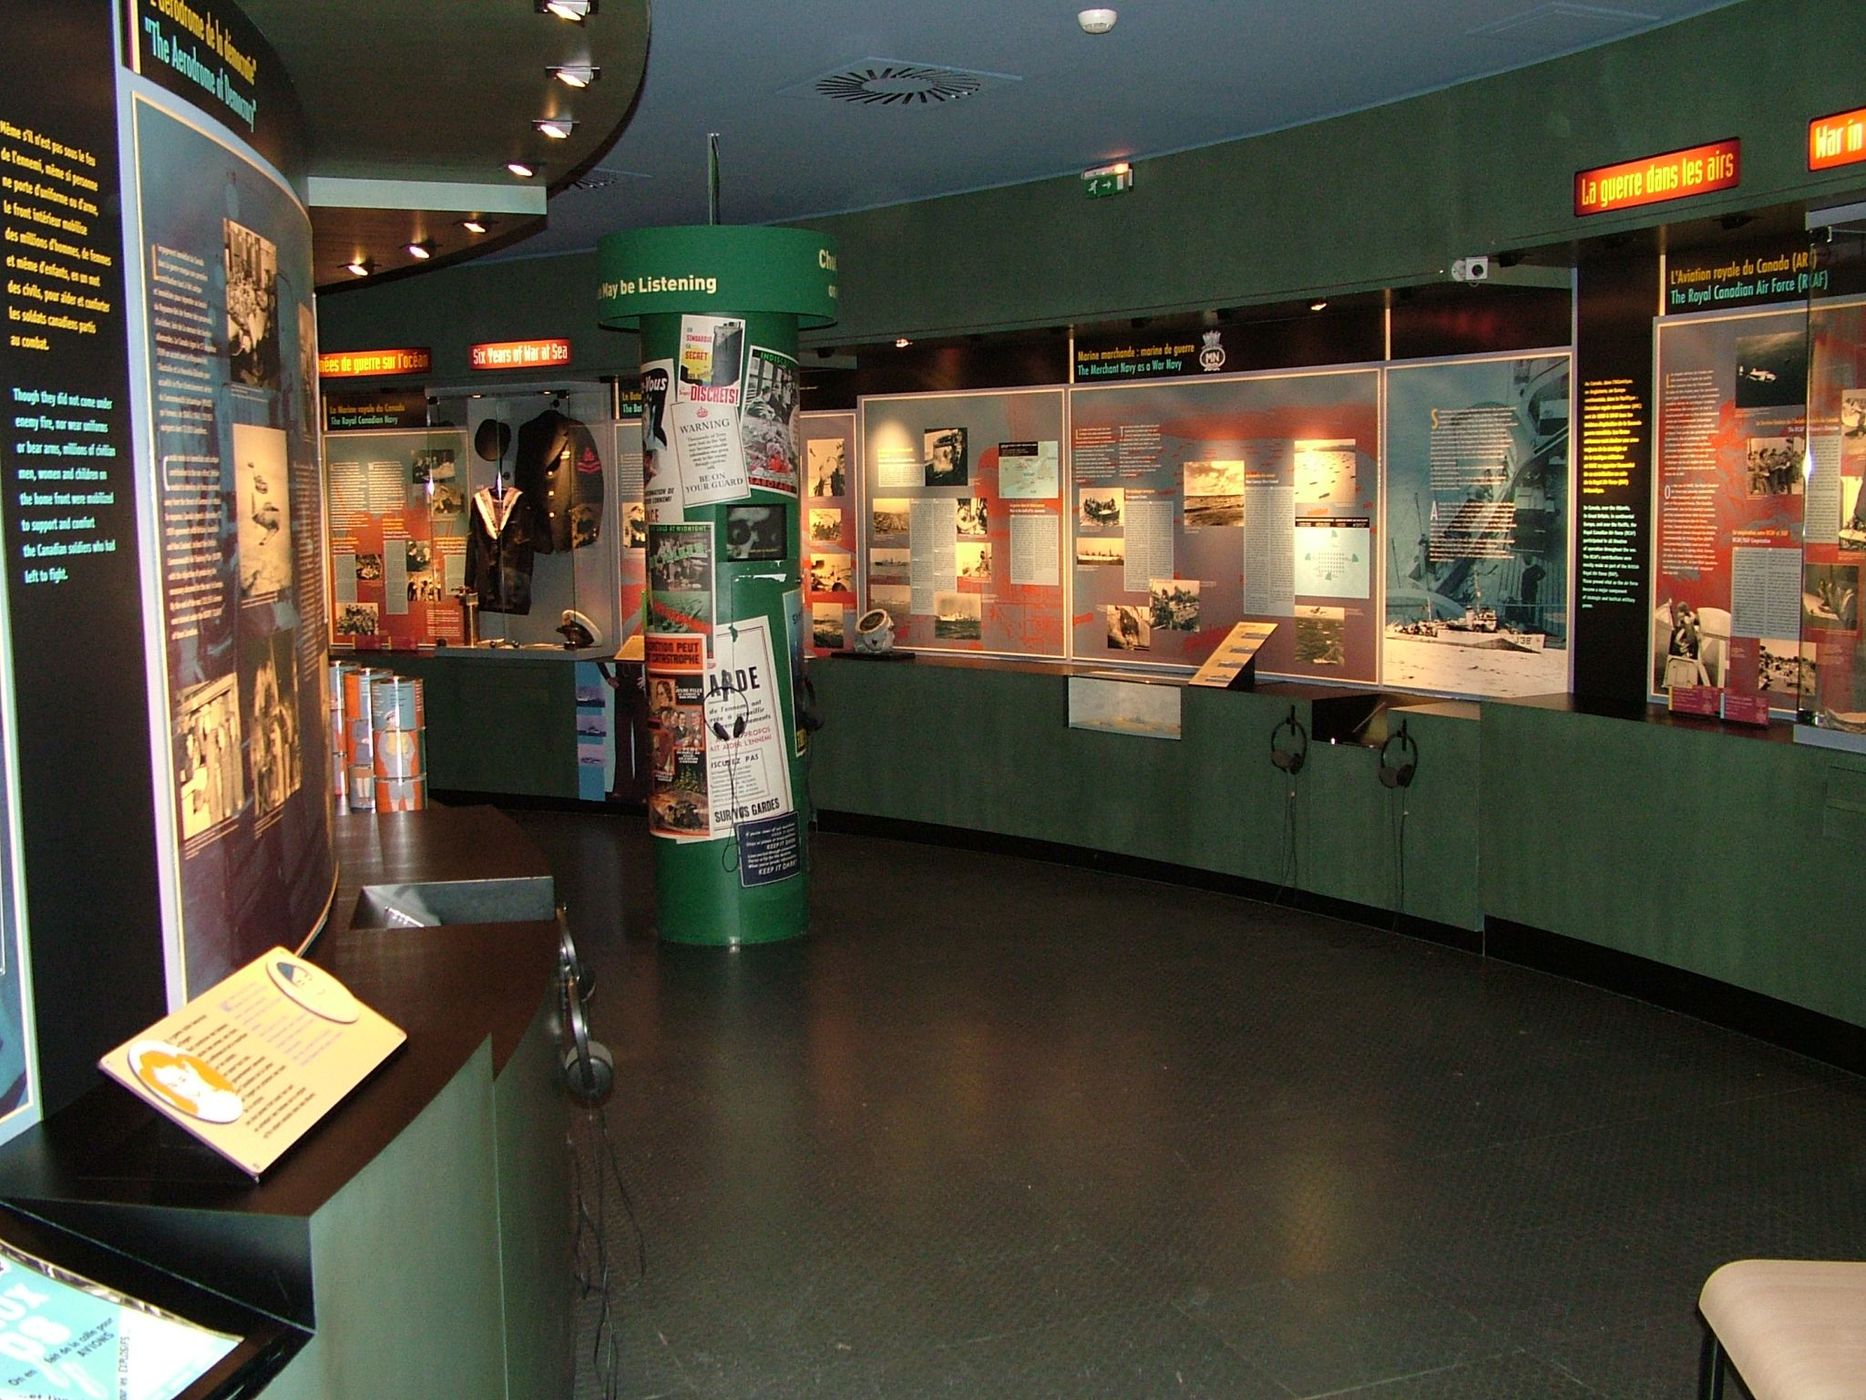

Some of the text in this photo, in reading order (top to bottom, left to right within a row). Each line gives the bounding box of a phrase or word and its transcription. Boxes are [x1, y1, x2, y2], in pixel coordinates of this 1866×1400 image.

[172, 35, 215, 94] Aerodrome
[1815, 118, 1864, 159] War in
[1582, 150, 1734, 208] La guerre dans les airs
[1671, 249, 1817, 285] L'Aviation royale du Canada (AR)
[602, 275, 717, 299] May be Listening
[1671, 289, 1686, 305] The
[1688, 286, 1712, 305] Royal
[1714, 280, 1754, 300] Canadian
[1756, 279, 1769, 295] Air
[1771, 277, 1796, 294] Force
[473, 343, 568, 365] Six Years of War at Sea
[685, 350, 708, 361] SECRET
[1078, 343, 1195, 361] Marine marchande marine de guerre
[1205, 351, 1220, 363] MN
[319, 353, 428, 374] nées de guerre sur l'océan
[1078, 364, 1089, 376] The
[1090, 361, 1119, 375] Merchant
[1120, 360, 1136, 375] Navy
[1137, 362, 1146, 372] as
[1152, 358, 1165, 371] War
[1166, 357, 1182, 372] Navy
[691, 386, 739, 405] DISCRETS!
[331, 415, 341, 425] The
[342, 416, 357, 426] Royal
[358, 415, 384, 425] Canadian
[680, 419, 730, 434] WARNING
[685, 478, 744, 493] YOUR GUARD
[699, 472, 726, 483] BE ON
[676, 642, 699, 653] PEUT
[745, 754, 759, 762] PAS
[714, 809, 732, 823] SUR
[751, 798, 780, 816] GARDES
[759, 866, 774, 875] KEEP
